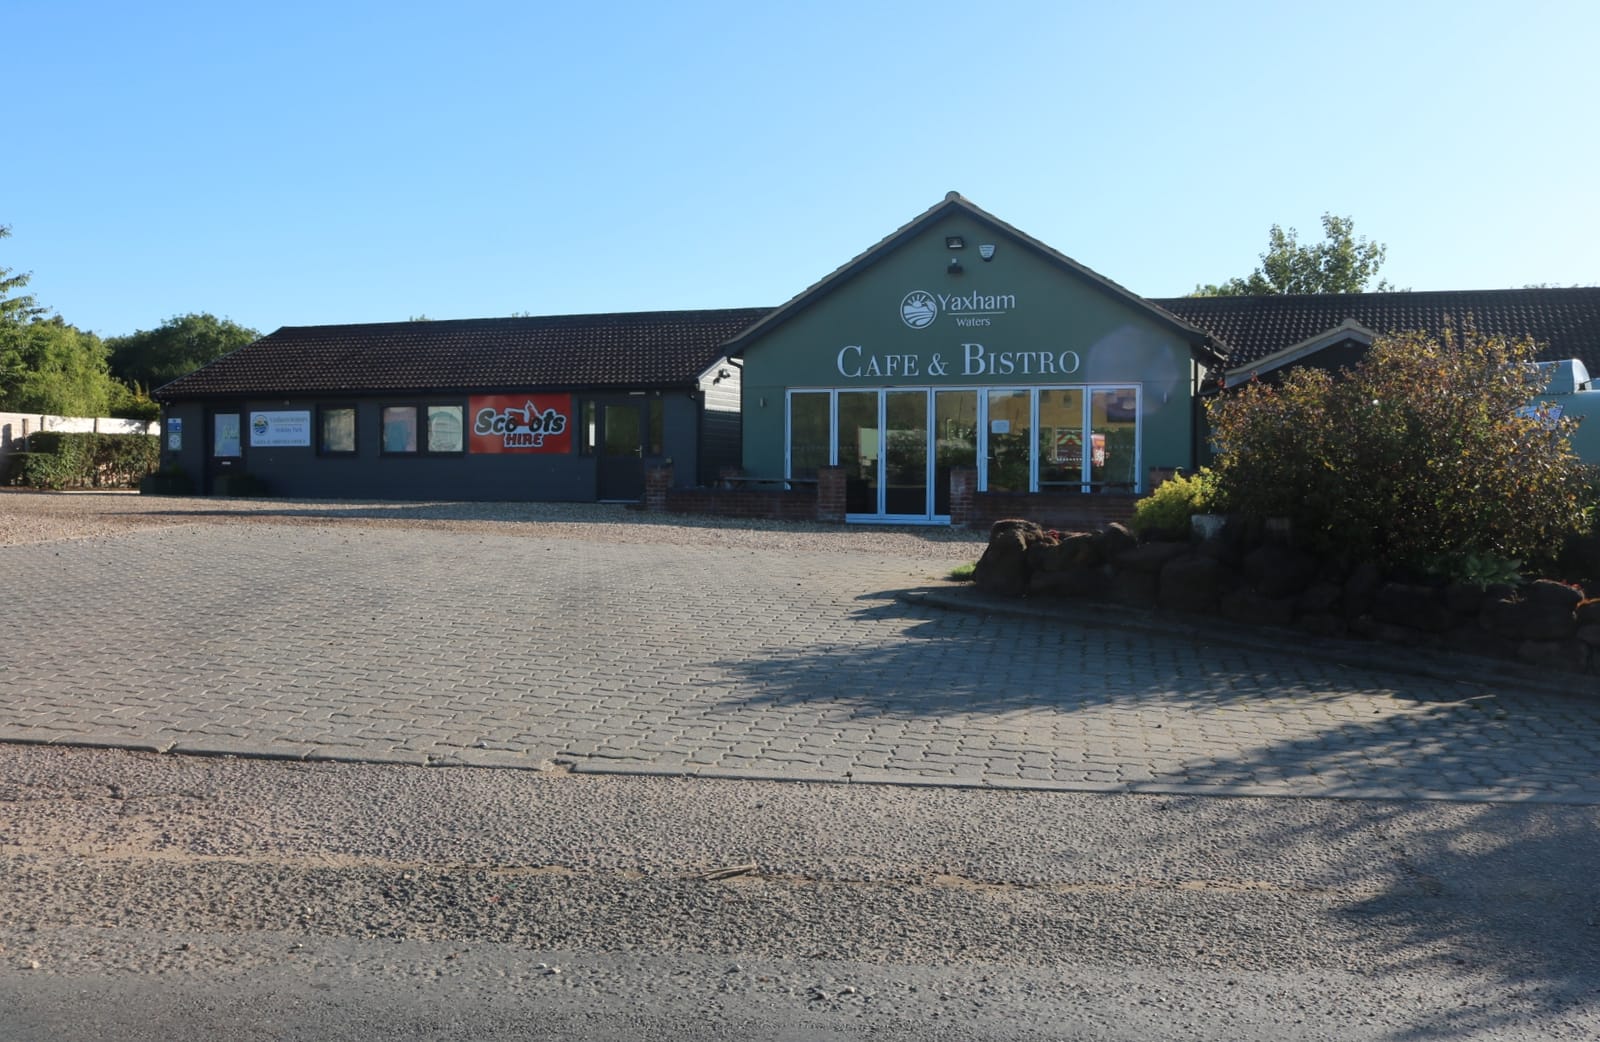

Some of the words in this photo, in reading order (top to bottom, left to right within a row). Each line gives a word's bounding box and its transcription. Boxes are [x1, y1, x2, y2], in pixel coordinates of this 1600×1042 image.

[937, 290, 1016, 311] Yaxham
[956, 318, 991, 327] Waters
[837, 345, 920, 377] CAFE
[927, 352, 949, 376] &
[961, 343, 1080, 376] BISTRO
[504, 433, 543, 447] HIRE
